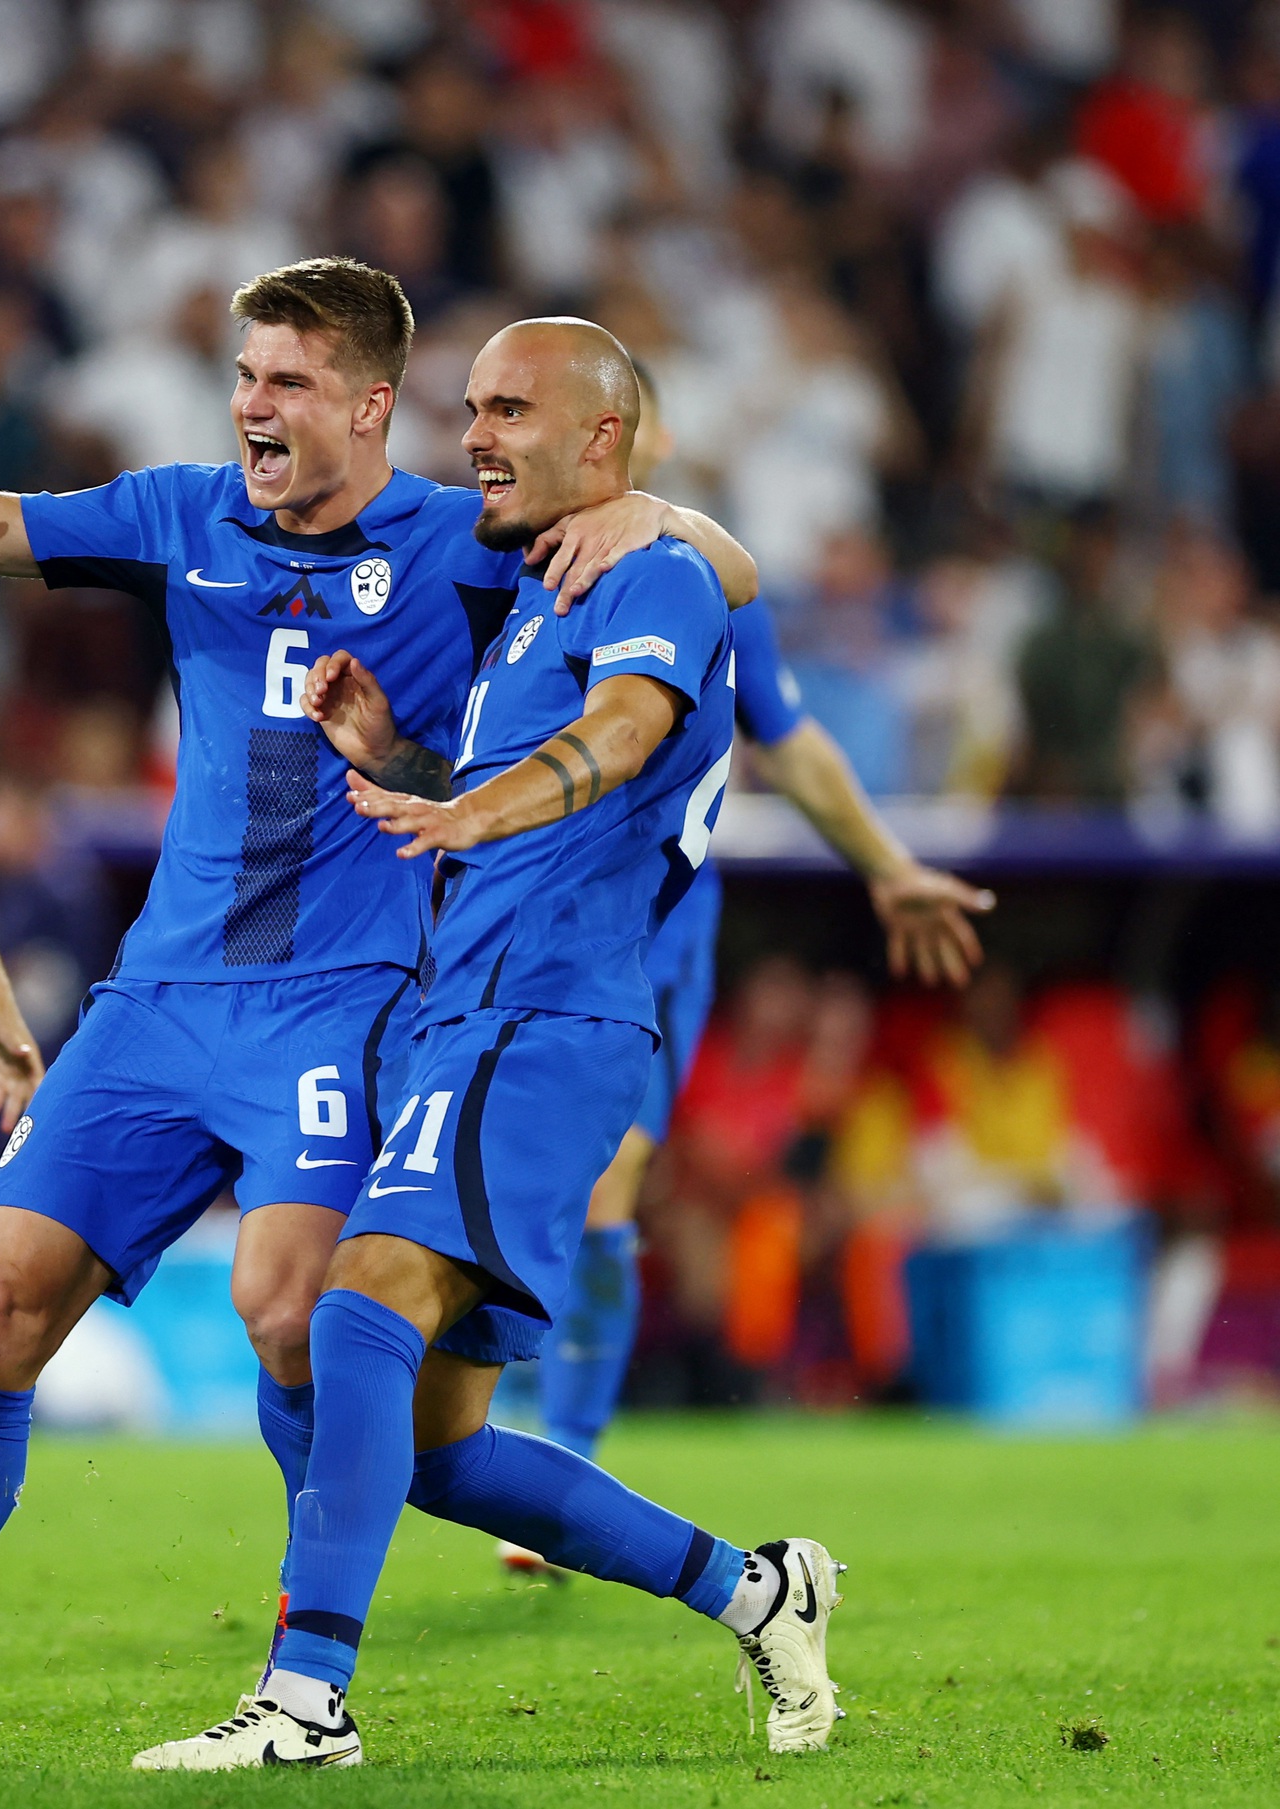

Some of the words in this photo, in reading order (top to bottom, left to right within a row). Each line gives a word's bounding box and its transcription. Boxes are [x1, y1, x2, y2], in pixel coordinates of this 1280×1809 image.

[261, 628, 310, 719] 6
[595, 641, 673, 659] FOUNDATION
[297, 1064, 348, 1138] 6
